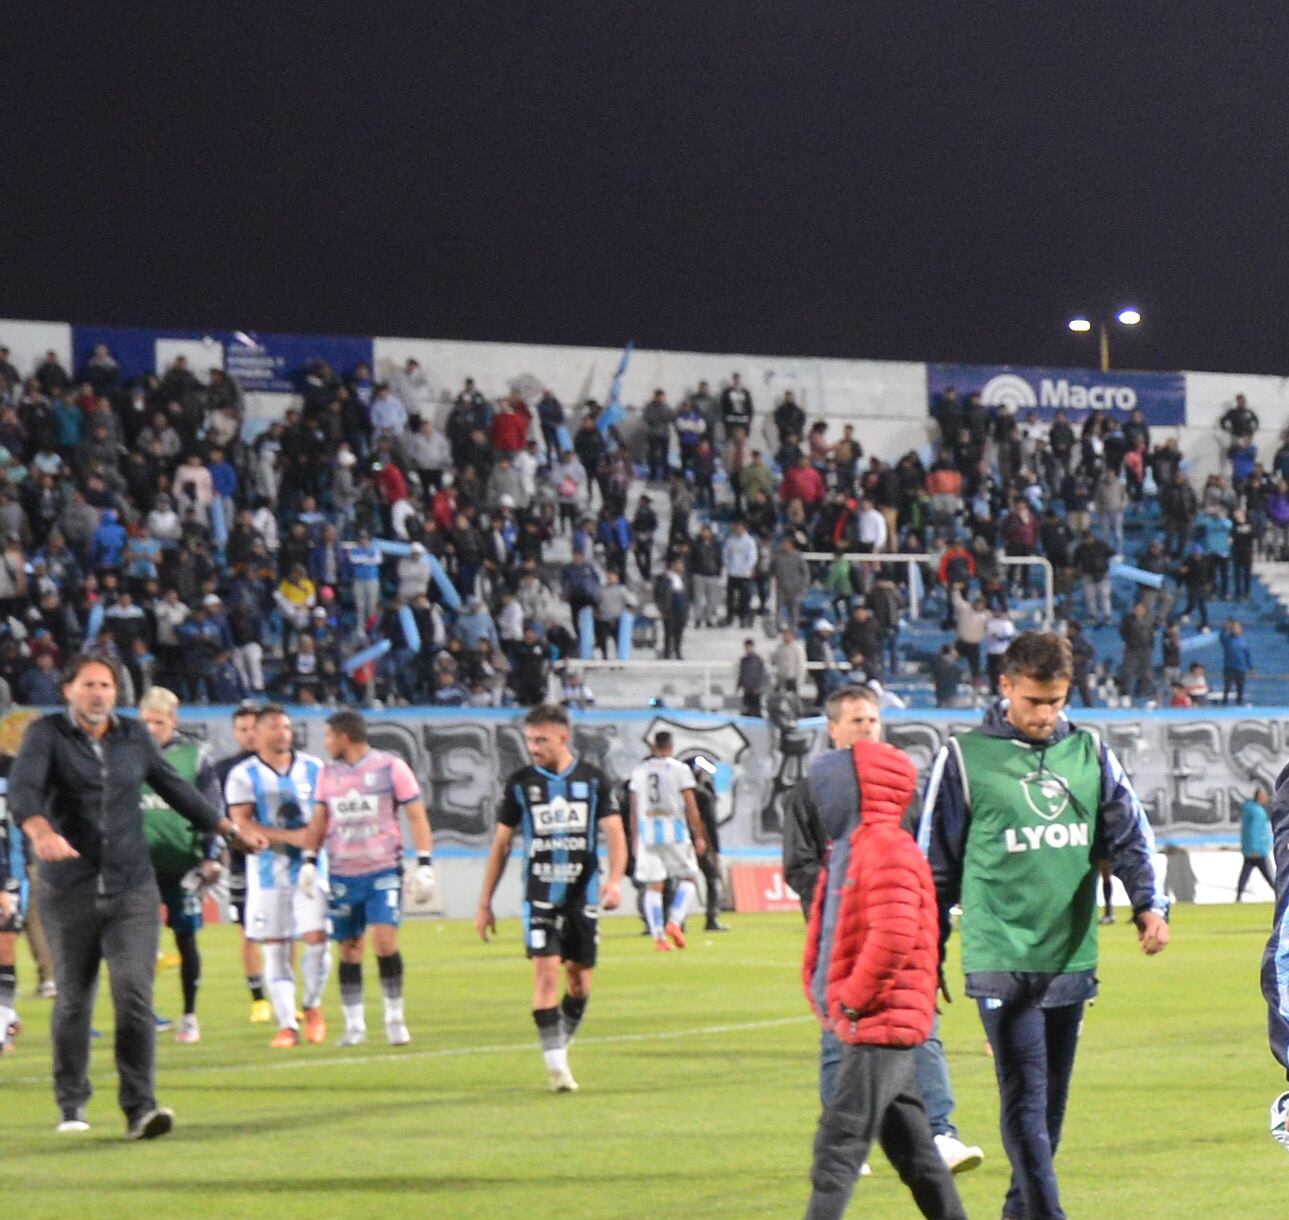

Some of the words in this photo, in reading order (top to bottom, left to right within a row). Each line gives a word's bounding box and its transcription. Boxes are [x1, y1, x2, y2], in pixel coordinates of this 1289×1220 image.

[1041, 378, 1136, 411] Macro
[337, 801, 372, 813] GEA
[540, 809, 579, 825] GEA
[1004, 822, 1088, 853] LYON
